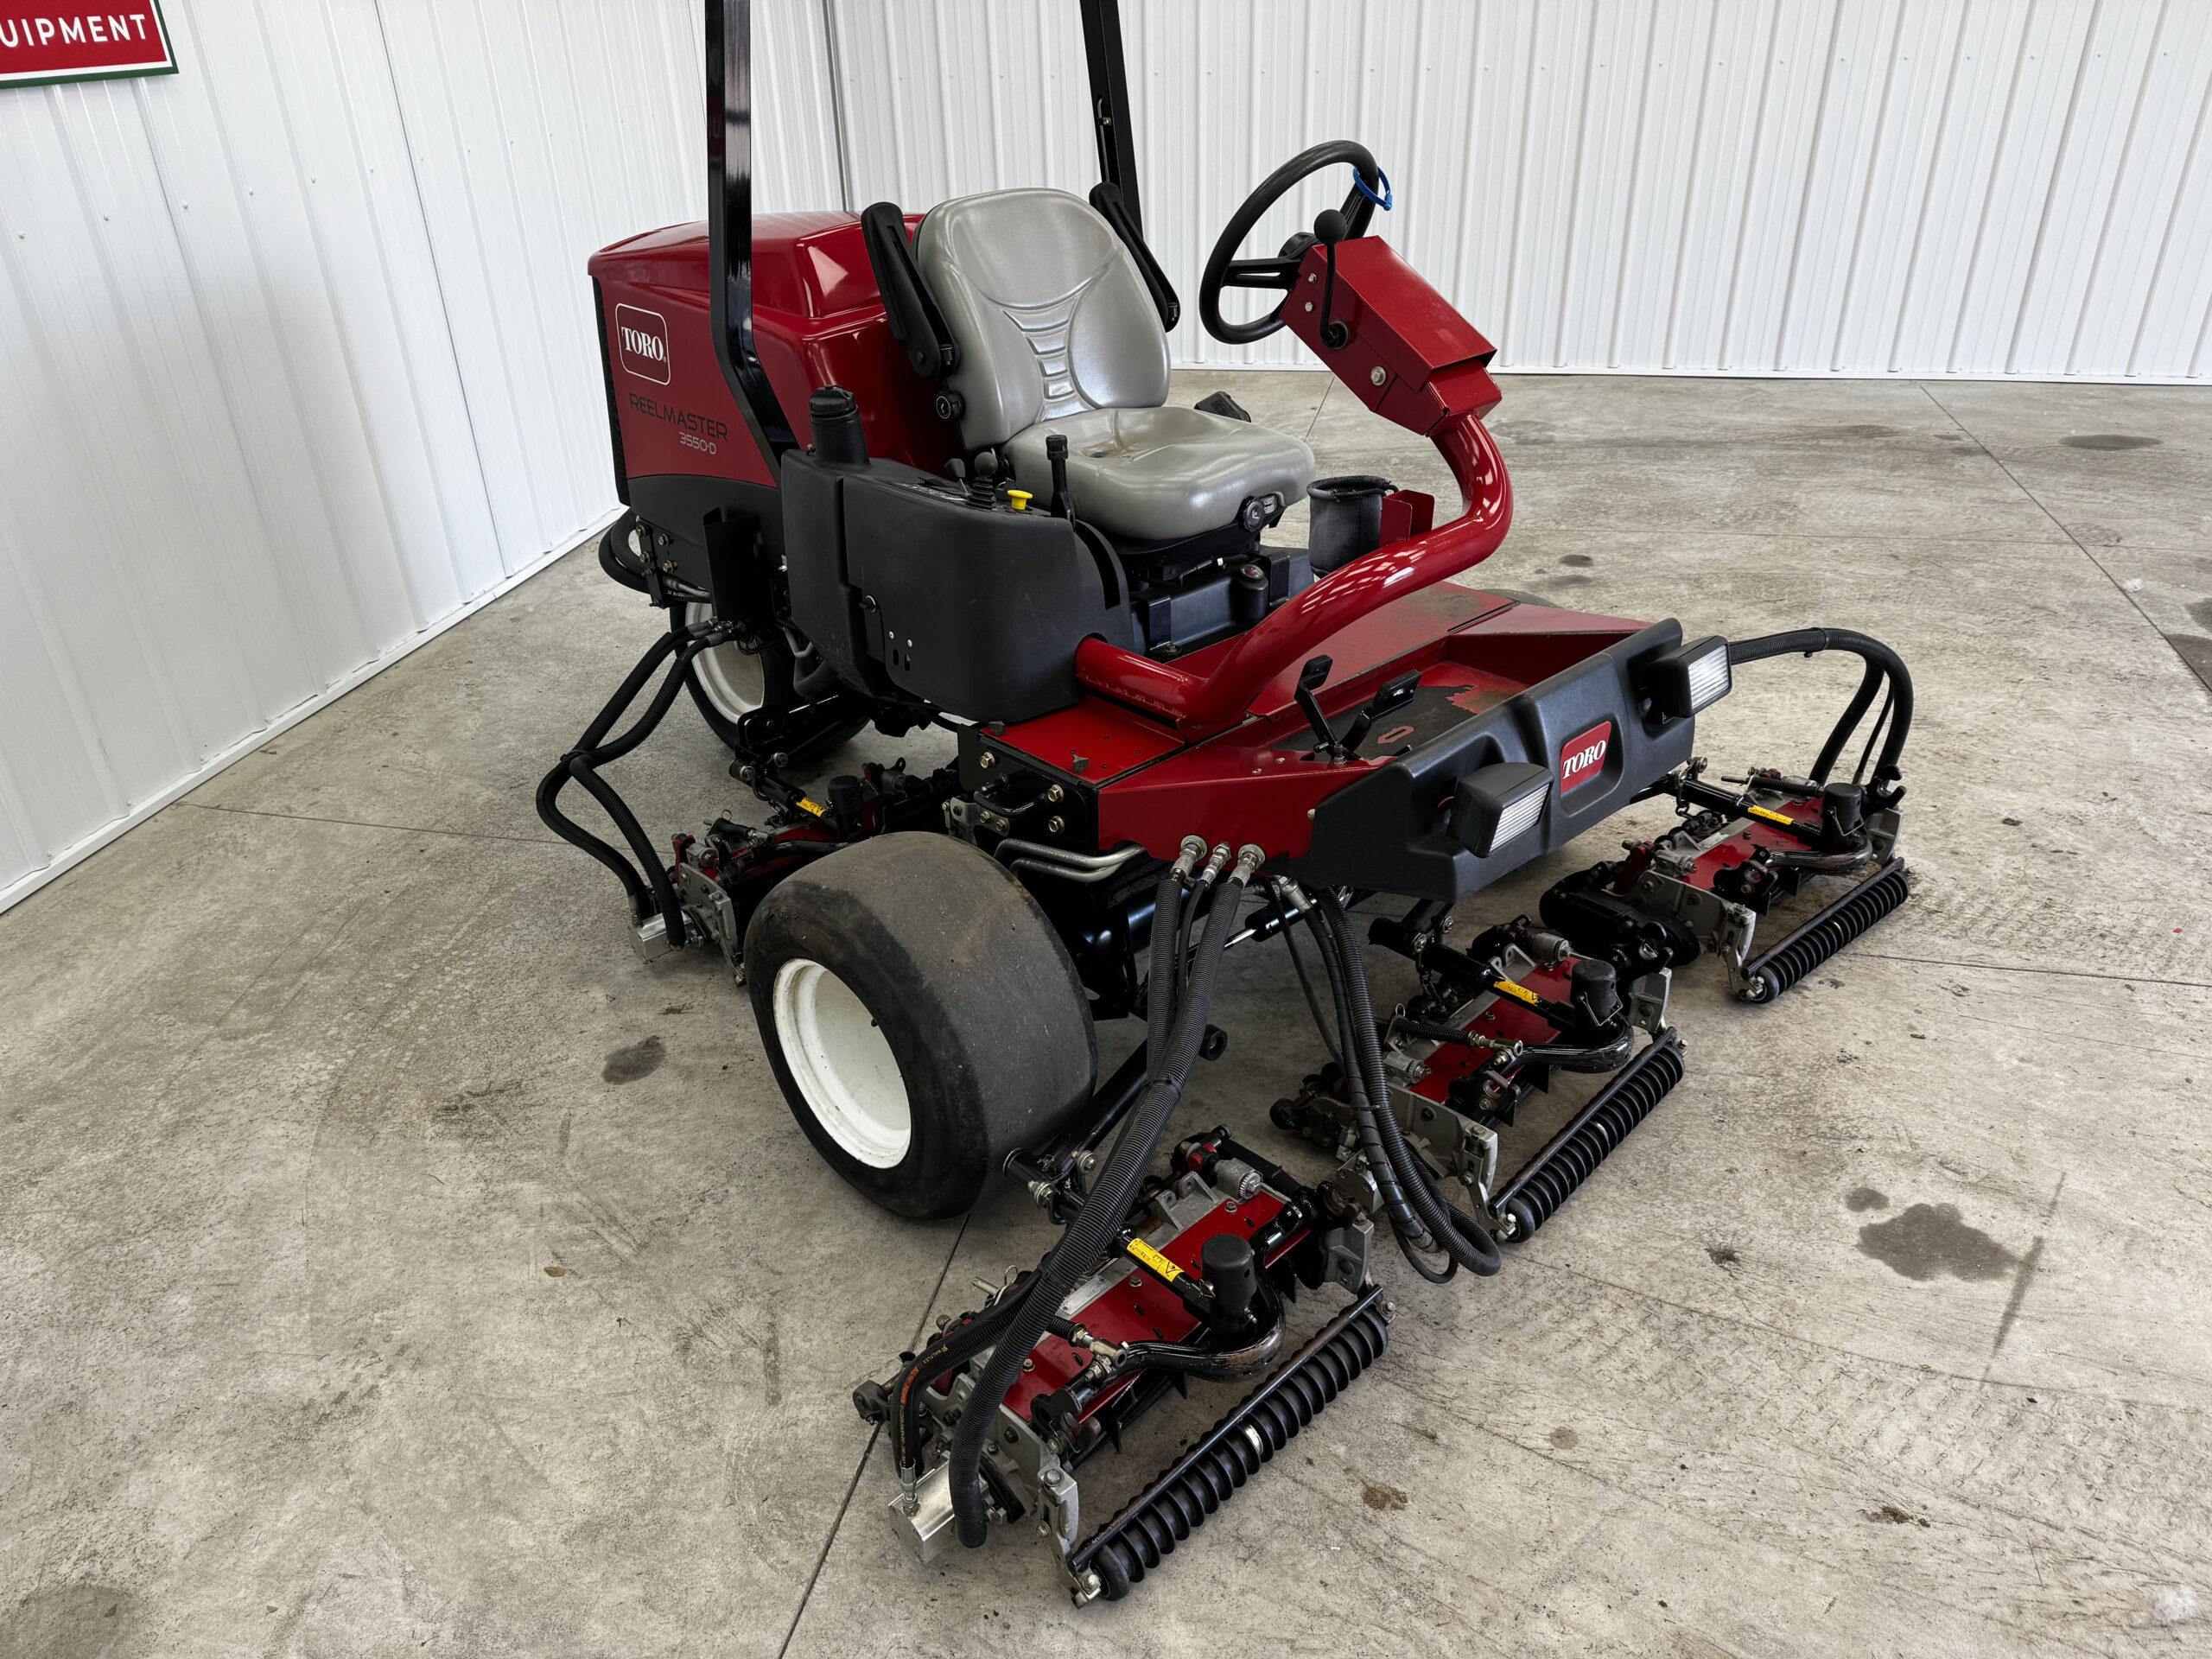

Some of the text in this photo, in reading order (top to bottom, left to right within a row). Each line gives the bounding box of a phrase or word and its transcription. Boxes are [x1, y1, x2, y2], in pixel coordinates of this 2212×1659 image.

[621, 327, 664, 361] TORO
[629, 392, 728, 442] REELMASTER
[1562, 740, 1606, 779] TORO
